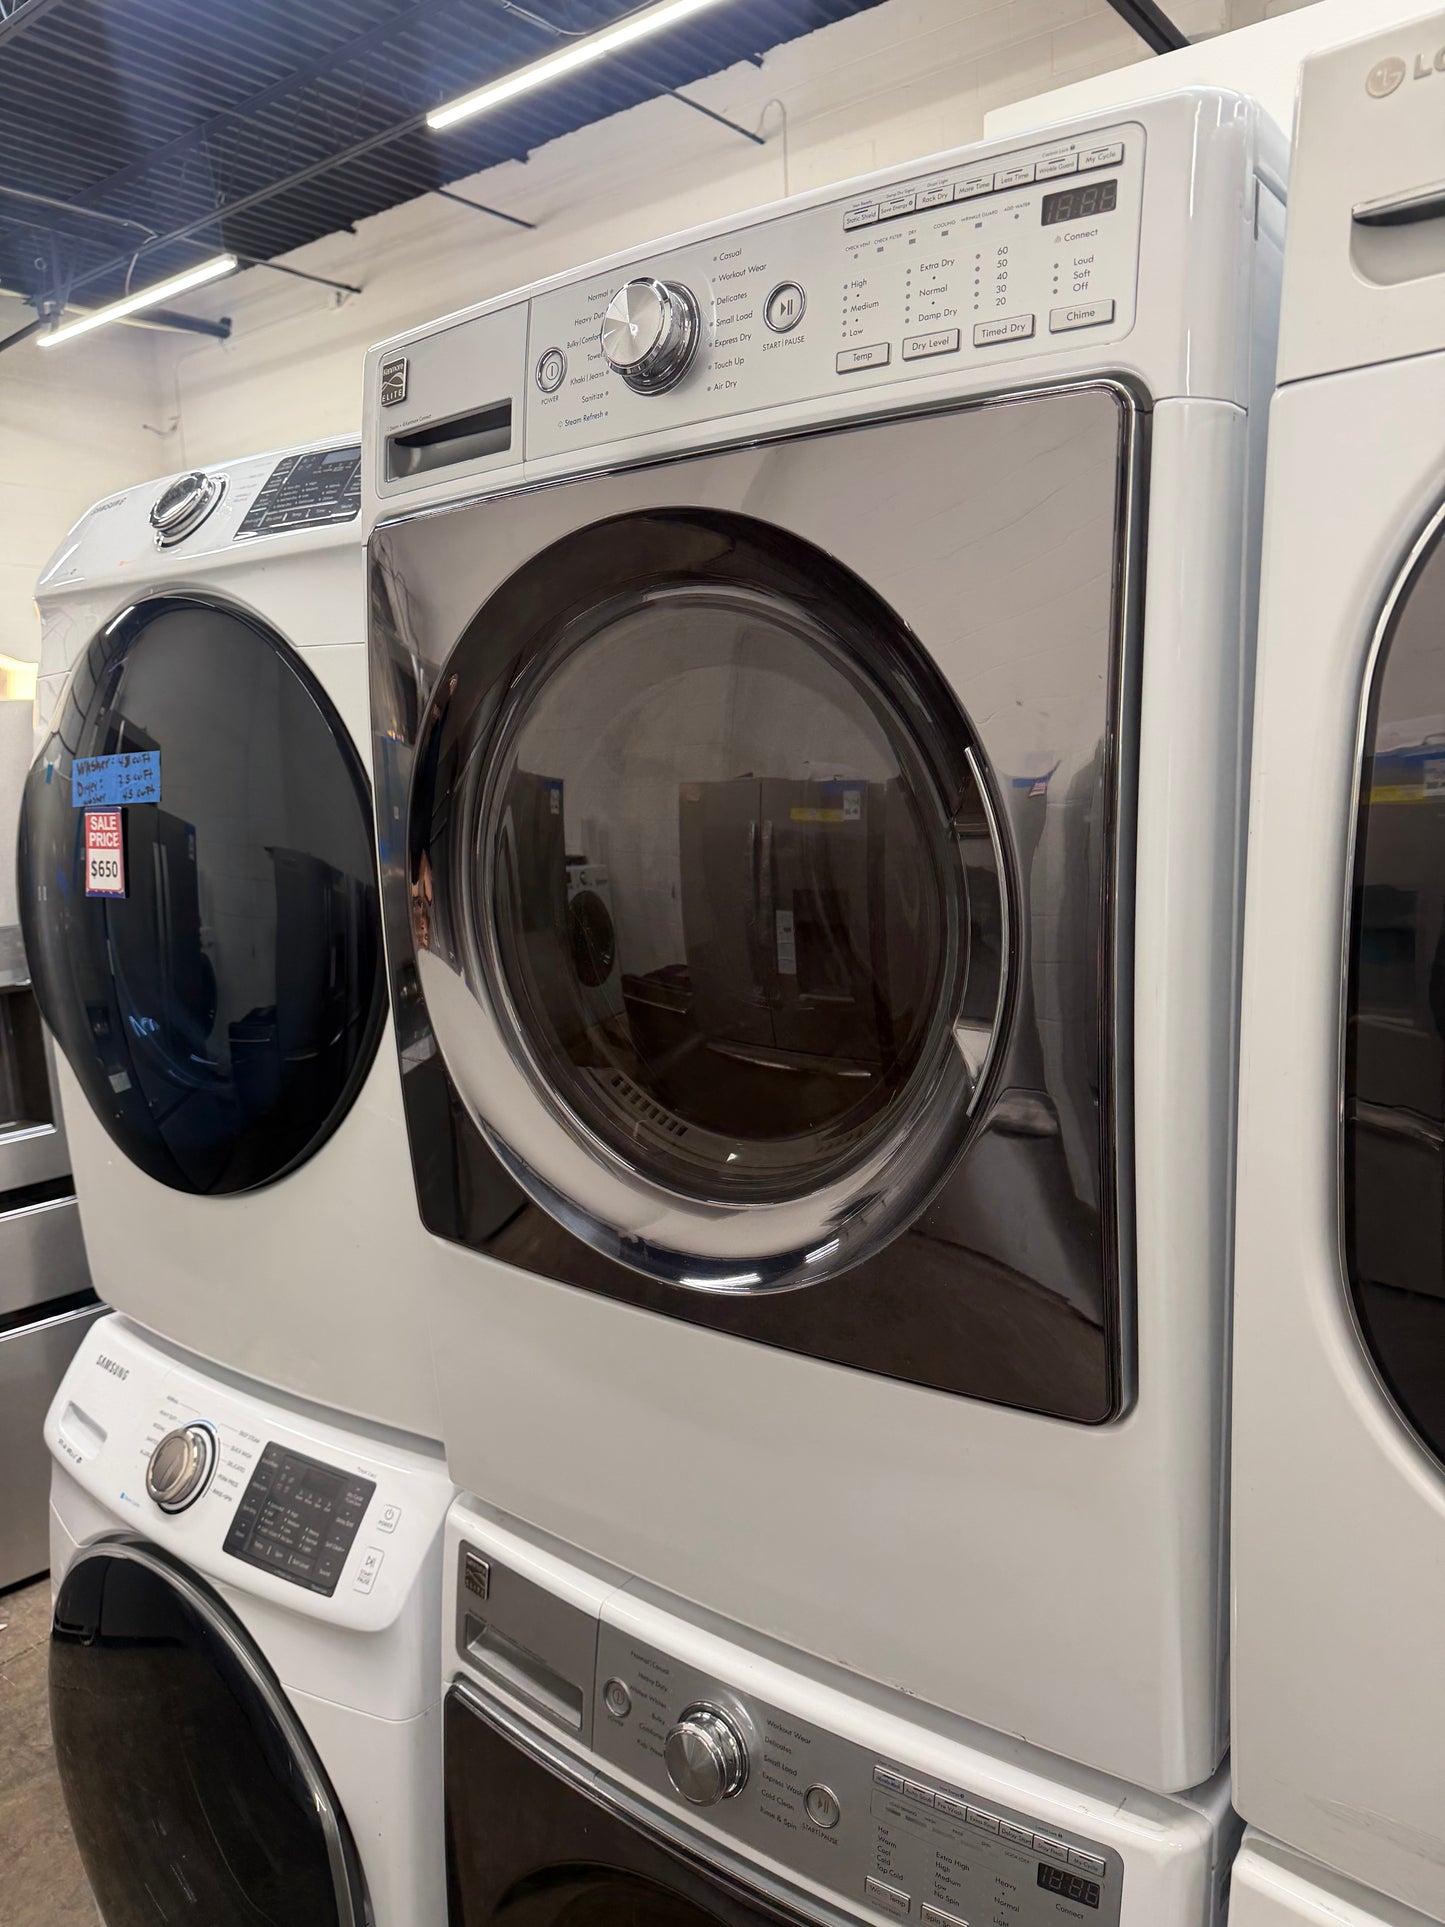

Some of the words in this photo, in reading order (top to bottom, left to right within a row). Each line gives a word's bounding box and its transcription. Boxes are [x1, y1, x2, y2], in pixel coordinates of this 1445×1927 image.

[1097, 152, 1116, 161] Cycle
[1014, 172, 1029, 181] Time
[959, 186, 974, 194] More
[976, 182, 990, 190] Time
[861, 212, 877, 221] Shield
[1064, 228, 1098, 242] Connect
[719, 248, 742, 261] Casual
[997, 246, 1009, 256] 60
[920, 262, 939, 272] Extra
[941, 258, 955, 268] Dry
[996, 258, 1008, 269] 50
[1073, 255, 1094, 266] Loud
[718, 269, 746, 282] Workout
[748, 263, 767, 274] Wear
[996, 271, 1008, 280] 40
[1073, 269, 1091, 280] Soft
[850, 278, 868, 289] High
[996, 284, 1007, 294] 30
[1072, 282, 1089, 292] Off
[587, 290, 609, 302] Normal
[919, 284, 948, 297] Normal
[716, 291, 748, 306] Delicates
[995, 296, 1007, 306] 20
[850, 300, 880, 313] Medium
[574, 316, 592, 327] Heavy
[593, 311, 606, 320] Dut
[716, 315, 735, 327] Small
[736, 310, 754, 322] Load
[918, 312, 942, 322] Damp
[943, 308, 958, 318] Dry
[1066, 309, 1096, 321] Chime
[849, 328, 864, 337] Low
[982, 325, 1008, 338] Timed
[1010, 322, 1026, 333] Dry
[714, 337, 738, 348] Express
[740, 332, 752, 342] Dry
[912, 342, 926, 351] Dry
[928, 336, 950, 348] Level
[714, 360, 733, 370] Touch
[734, 357, 745, 366] Up
[852, 352, 873, 362] Temp
[713, 382, 724, 392] Air
[725, 380, 738, 389] Dry
[382, 388, 402, 403] ELITE
[540, 394, 560, 406] POWER
[581, 392, 604, 404] Sanitize
[564, 417, 582, 427] Steam
[583, 410, 604, 422] Refresh
[90, 816, 118, 831] SALE
[89, 832, 120, 848] PRICE
[90, 858, 119, 879] $650
[96, 1354, 130, 1381] SAMSUNG
[766, 1719, 792, 1737] Workout
[793, 1731, 812, 1744] Wear
[764, 1735, 792, 1755] Delicates
[764, 1754, 780, 1768] Small
[782, 1762, 798, 1777] Load
[762, 1771, 784, 1788] Express
[786, 1783, 804, 1798] Wash
[761, 1789, 776, 1802] Cold
[776, 1796, 795, 1811] Clean
[776, 1815, 782, 1823] &
[783, 1818, 797, 1832] Spin
[878, 1826, 889, 1836] Hot
[1001, 1828, 1018, 1840] Delay
[878, 1835, 897, 1849] Warm
[877, 1846, 892, 1856] Cool
[876, 1854, 891, 1866] Cold
[936, 1851, 953, 1864] Extra
[954, 1860, 970, 1872] High
[876, 1863, 888, 1874] Tap
[888, 1870, 904, 1881] Cold
[936, 1862, 951, 1873] High
[934, 1881, 947, 1892] Low
[935, 1872, 962, 1888] Medium
[994, 1876, 1017, 1892] Heavy
[889, 1895, 906, 1908] Temp
[934, 1890, 944, 1900] No
[946, 1895, 960, 1907] Spin
[994, 1896, 1020, 1913] Normal
[1055, 1903, 1084, 1920] Connect
[926, 1912, 941, 1925] Spin
